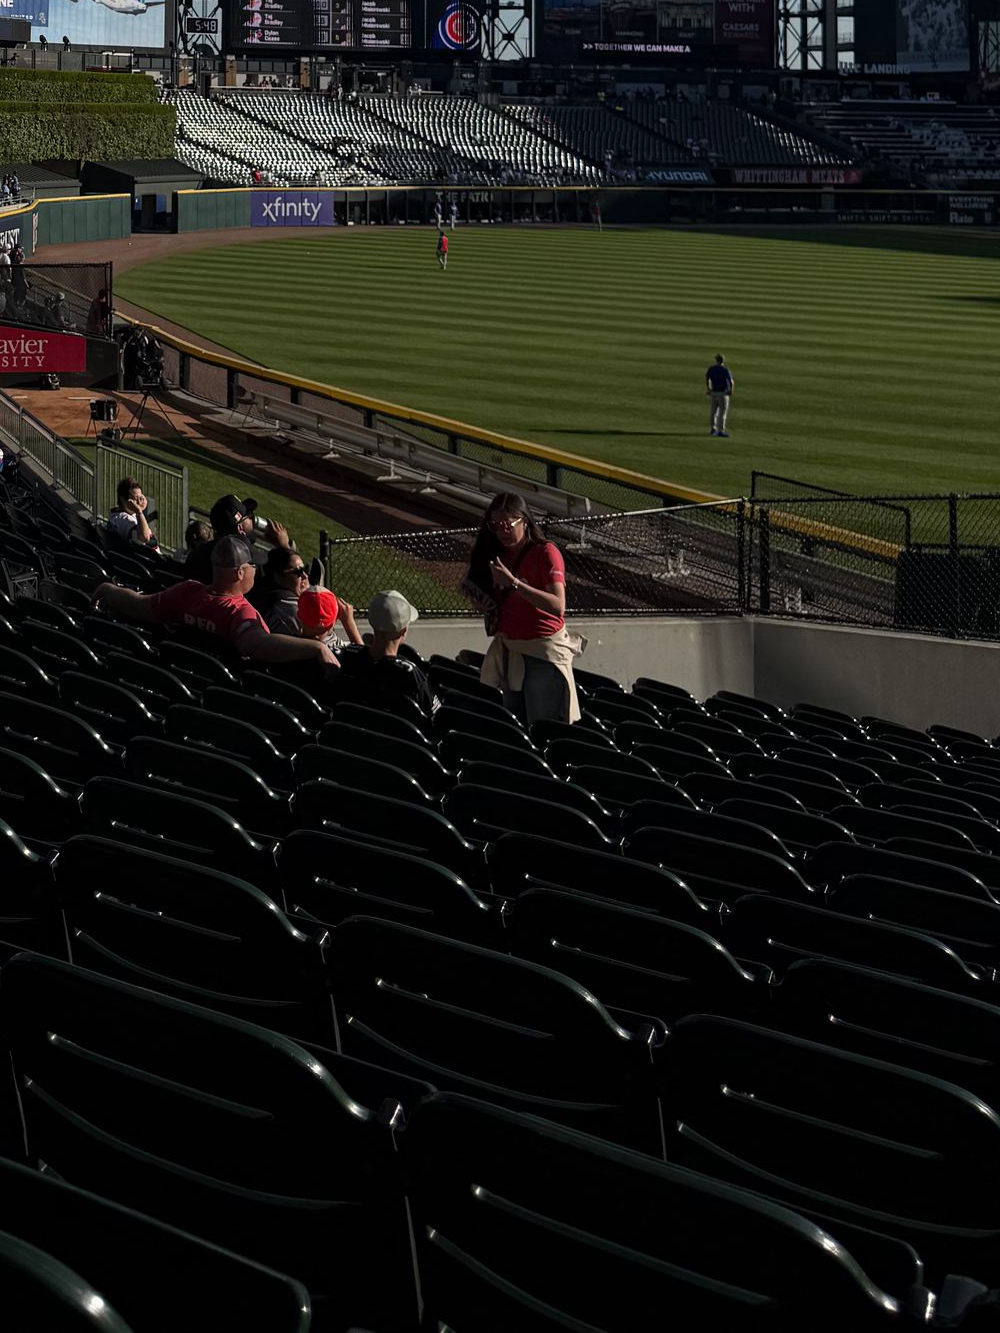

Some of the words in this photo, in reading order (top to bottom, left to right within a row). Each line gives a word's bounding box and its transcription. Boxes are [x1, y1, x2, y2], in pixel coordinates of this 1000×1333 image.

[728, 3, 755, 13] WITH
[195, 20, 217, 32] 5:48
[594, 43, 633, 52] TOGETHER
[633, 44, 646, 52] WE
[646, 44, 662, 52] CAN
[663, 44, 683, 53] MAKE
[863, 62, 911, 75] LANDING
[735, 170, 808, 184] WHITTINGHAM
[811, 169, 845, 184] MEATS
[435, 191, 458, 202] THE
[262, 196, 322, 222] xfinity
